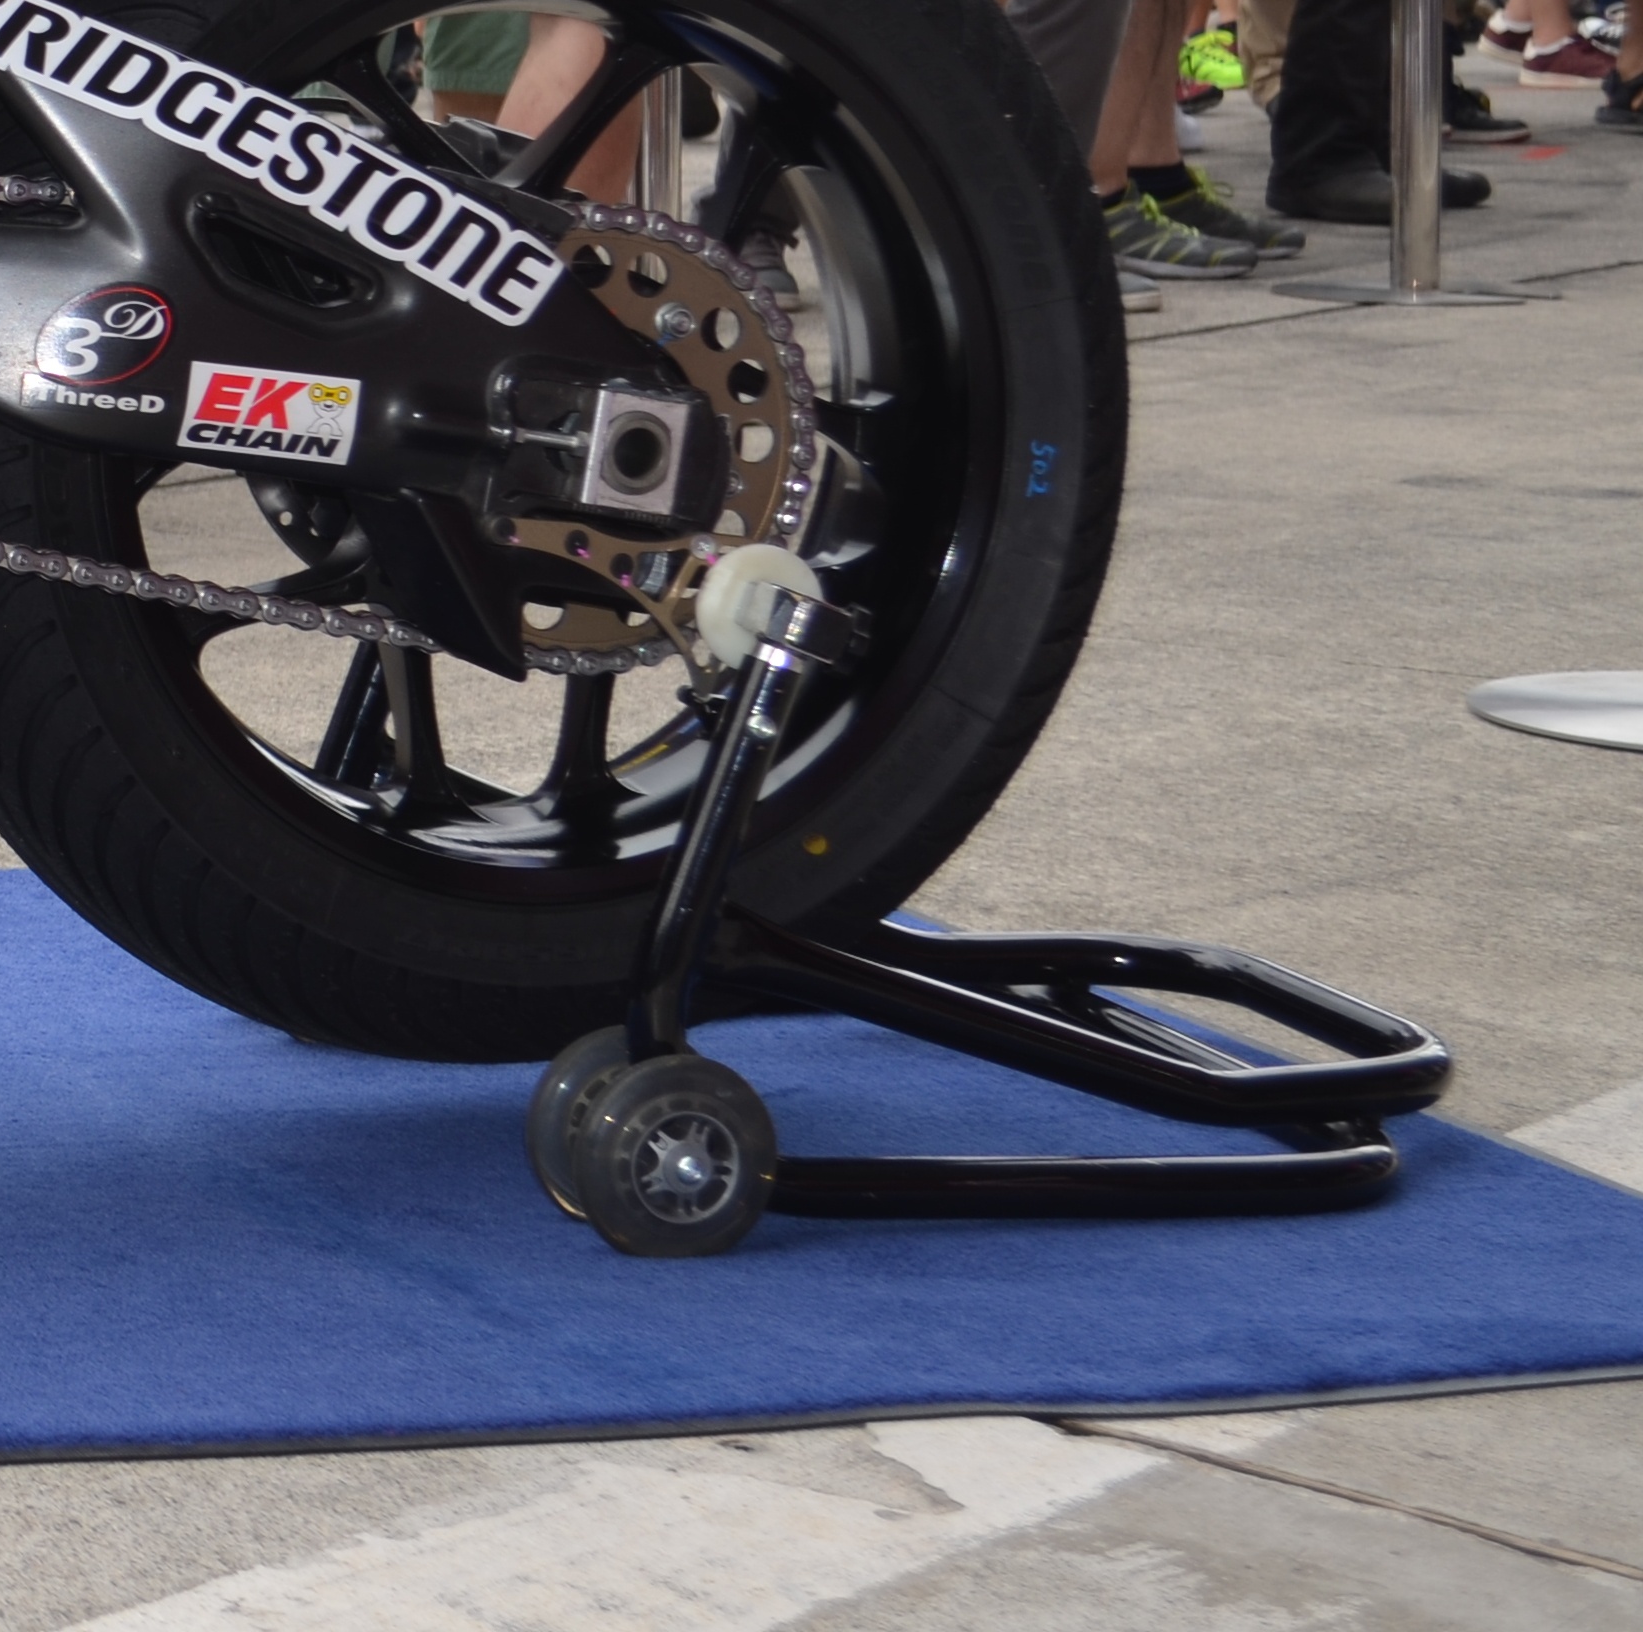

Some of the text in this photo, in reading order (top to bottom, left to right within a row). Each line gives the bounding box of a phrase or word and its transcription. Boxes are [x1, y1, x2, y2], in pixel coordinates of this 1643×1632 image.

[193, 371, 312, 431] EK
[185, 422, 343, 459] CHAIN
[1025, 440, 1056, 499] 502
